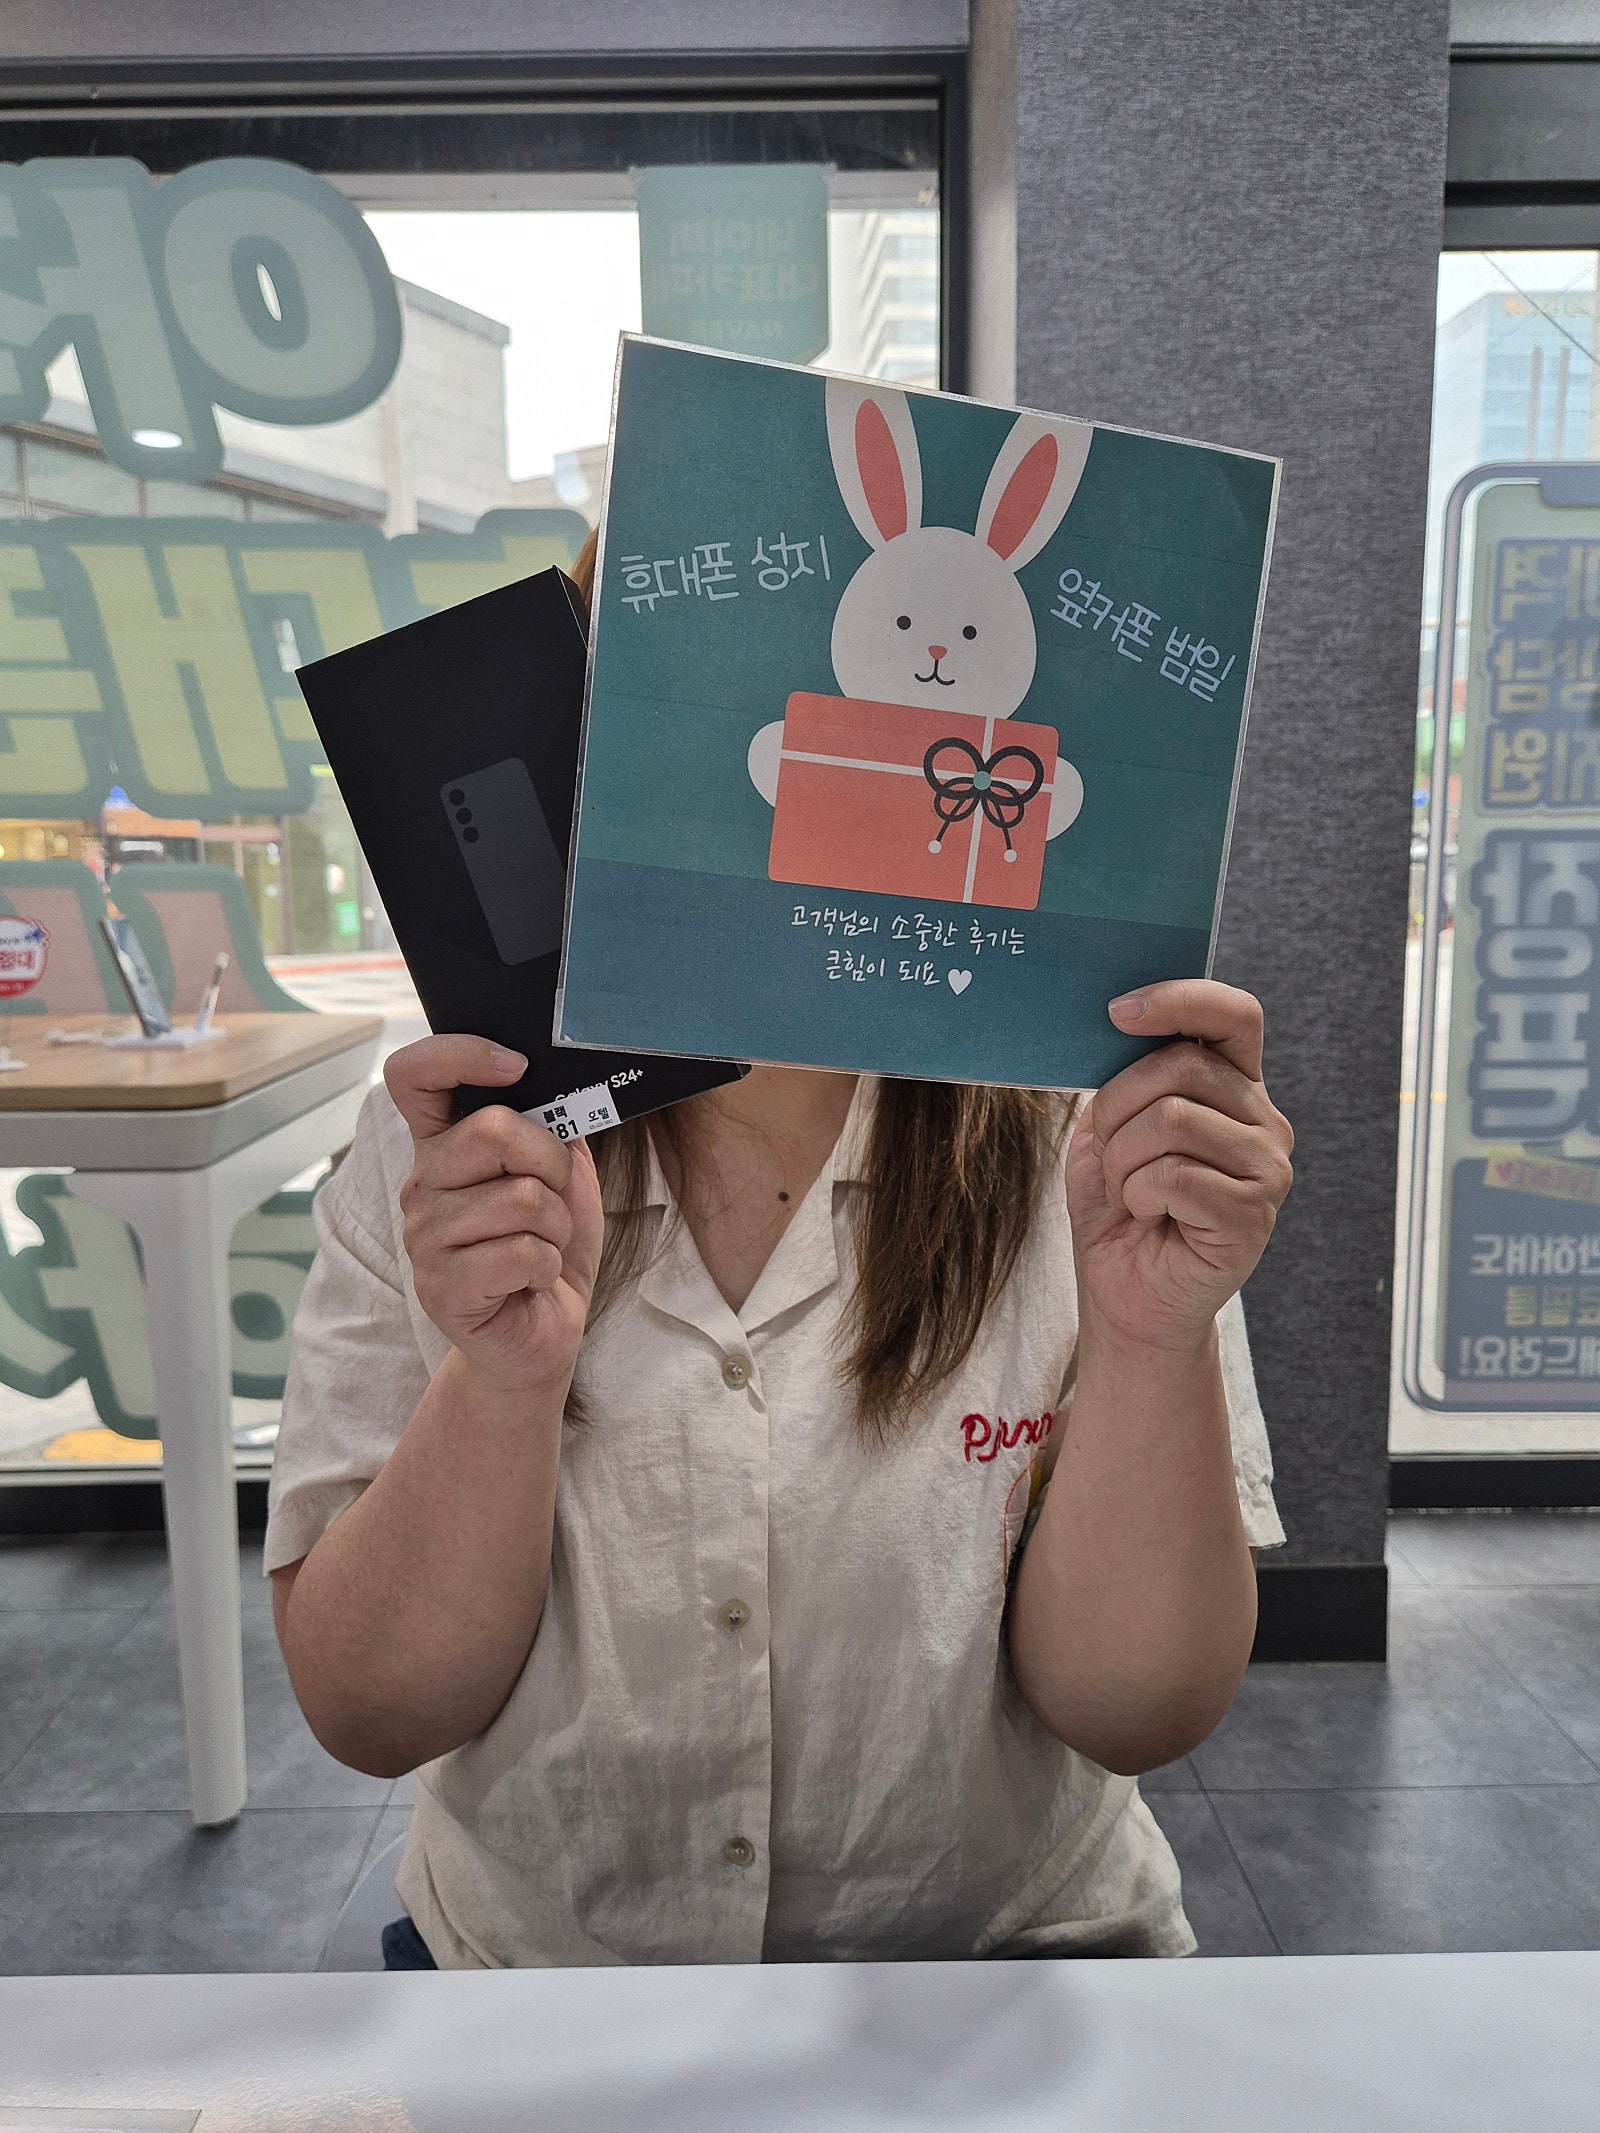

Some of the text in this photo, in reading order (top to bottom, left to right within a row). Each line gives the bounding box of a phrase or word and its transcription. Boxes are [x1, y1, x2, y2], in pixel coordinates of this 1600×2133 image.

[620, 531, 833, 614] 휴대폰 성지
[1050, 567, 1237, 703] 옆커폰 범일
[790, 905, 1026, 955] 고객님의 소중한 후기는
[825, 949, 941, 986] 큰힘이 되요
[610, 1068, 644, 1088] S24+
[543, 1105, 567, 1124] 블랙
